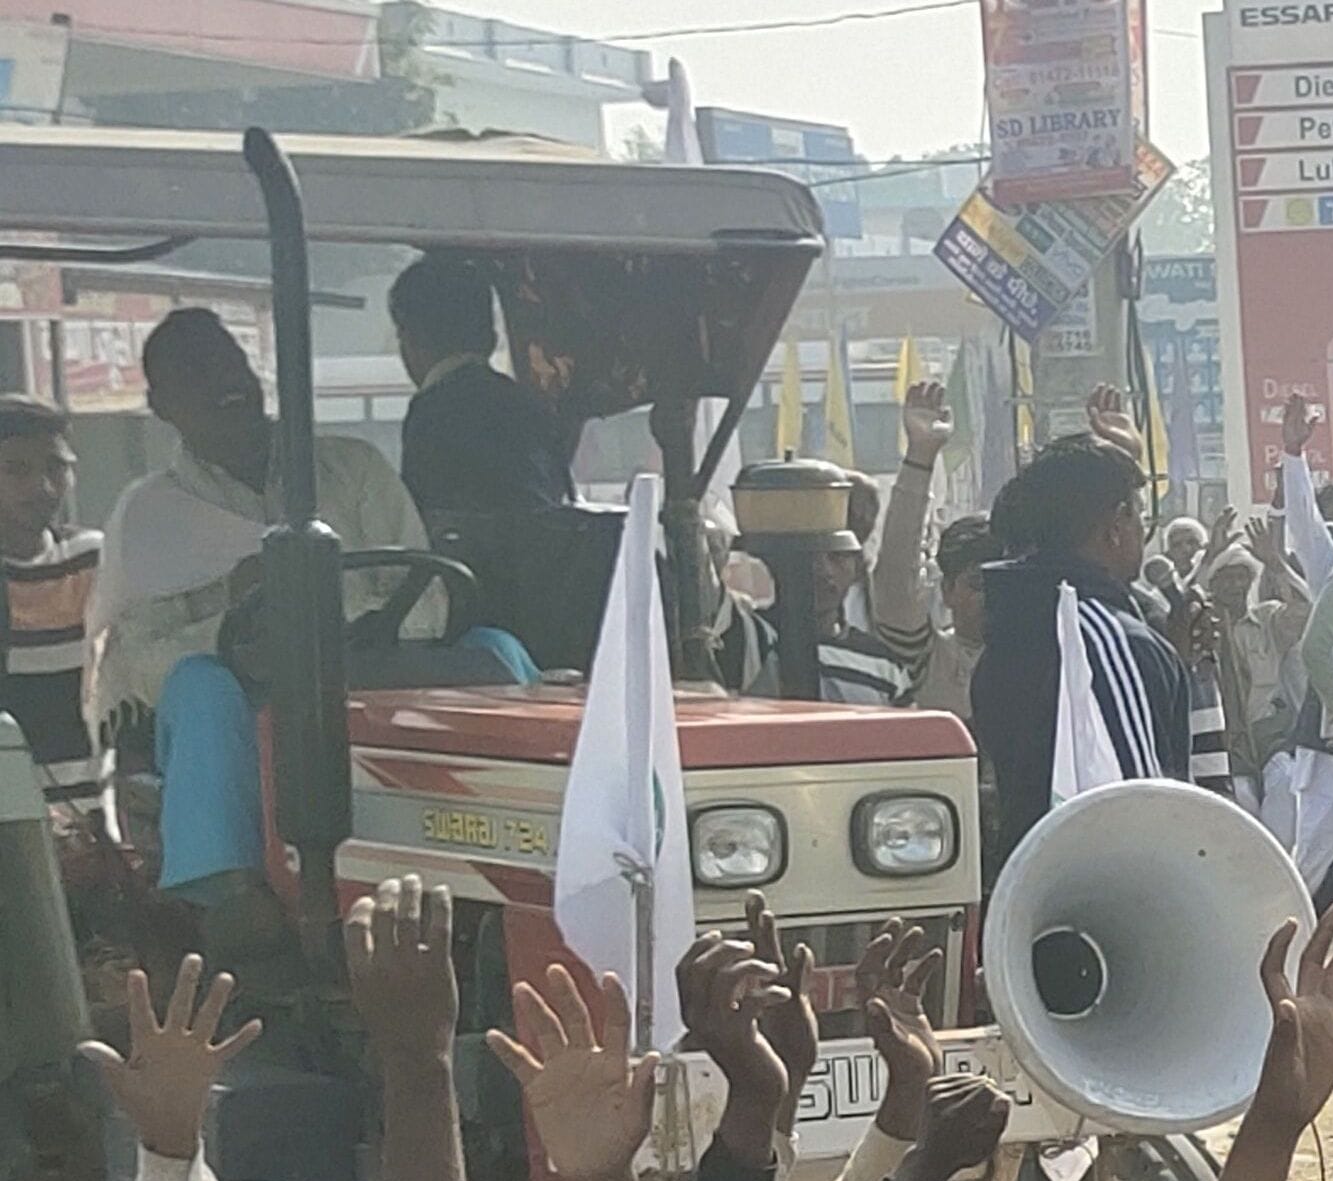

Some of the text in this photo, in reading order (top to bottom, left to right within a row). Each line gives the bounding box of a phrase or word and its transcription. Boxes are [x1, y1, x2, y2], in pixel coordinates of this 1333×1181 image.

[996, 108, 1122, 139] SD LIBRARY
[504, 818, 550, 856] 724
